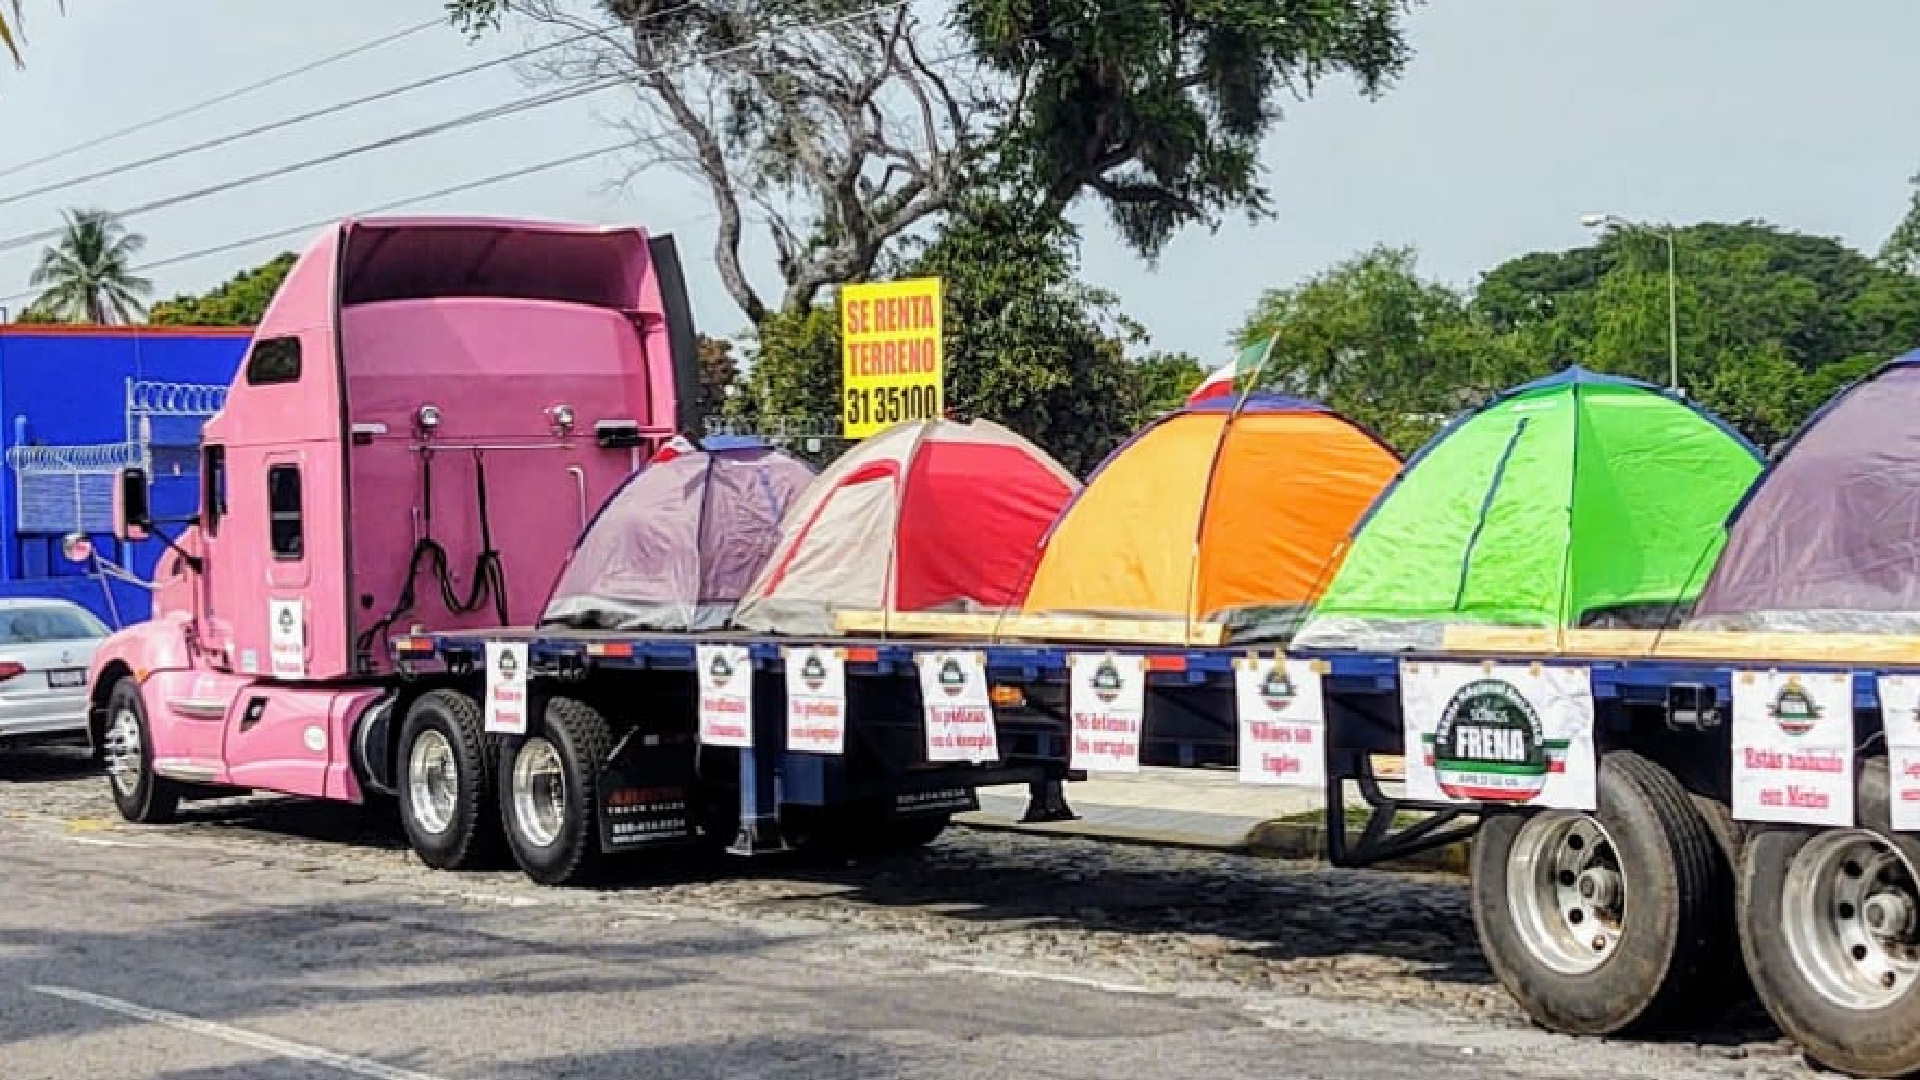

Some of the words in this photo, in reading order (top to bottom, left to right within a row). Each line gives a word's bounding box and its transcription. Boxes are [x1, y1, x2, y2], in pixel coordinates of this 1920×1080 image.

[847, 299, 870, 334] SE
[873, 295, 934, 332] RENTA
[847, 338, 936, 376] TERRENO
[1455, 725, 1526, 762] FRENA
